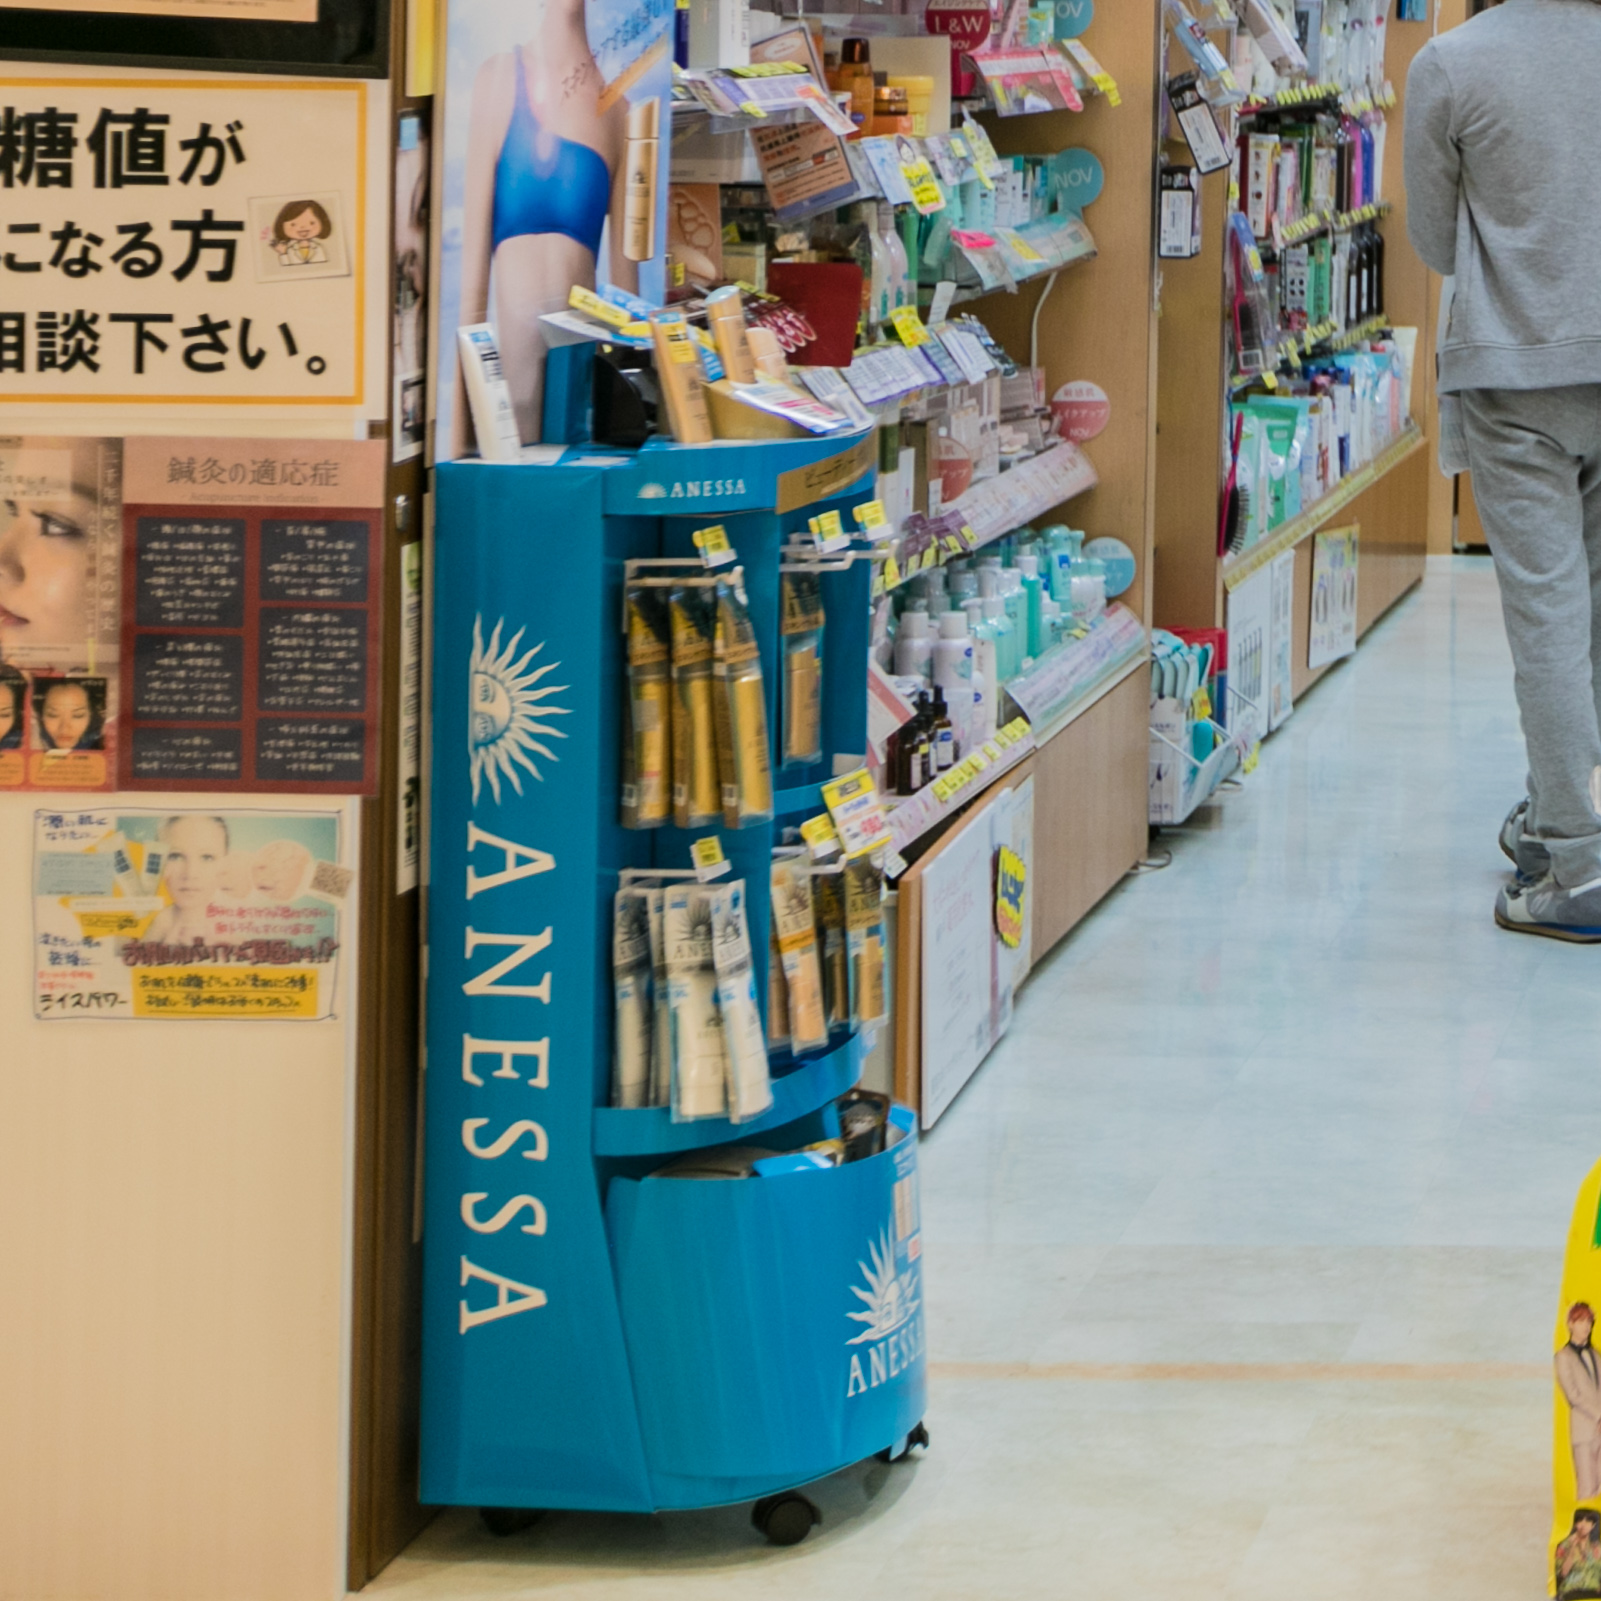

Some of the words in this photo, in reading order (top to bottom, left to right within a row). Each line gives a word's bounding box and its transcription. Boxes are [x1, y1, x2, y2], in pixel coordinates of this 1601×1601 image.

[934, 15, 984, 34] L&W
[1054, 155, 1094, 185] NOV
[167, 456, 340, 487] 鍼灸の適応症
[671, 479, 747, 498] ANESSA
[458, 820, 558, 1336] ANESSA
